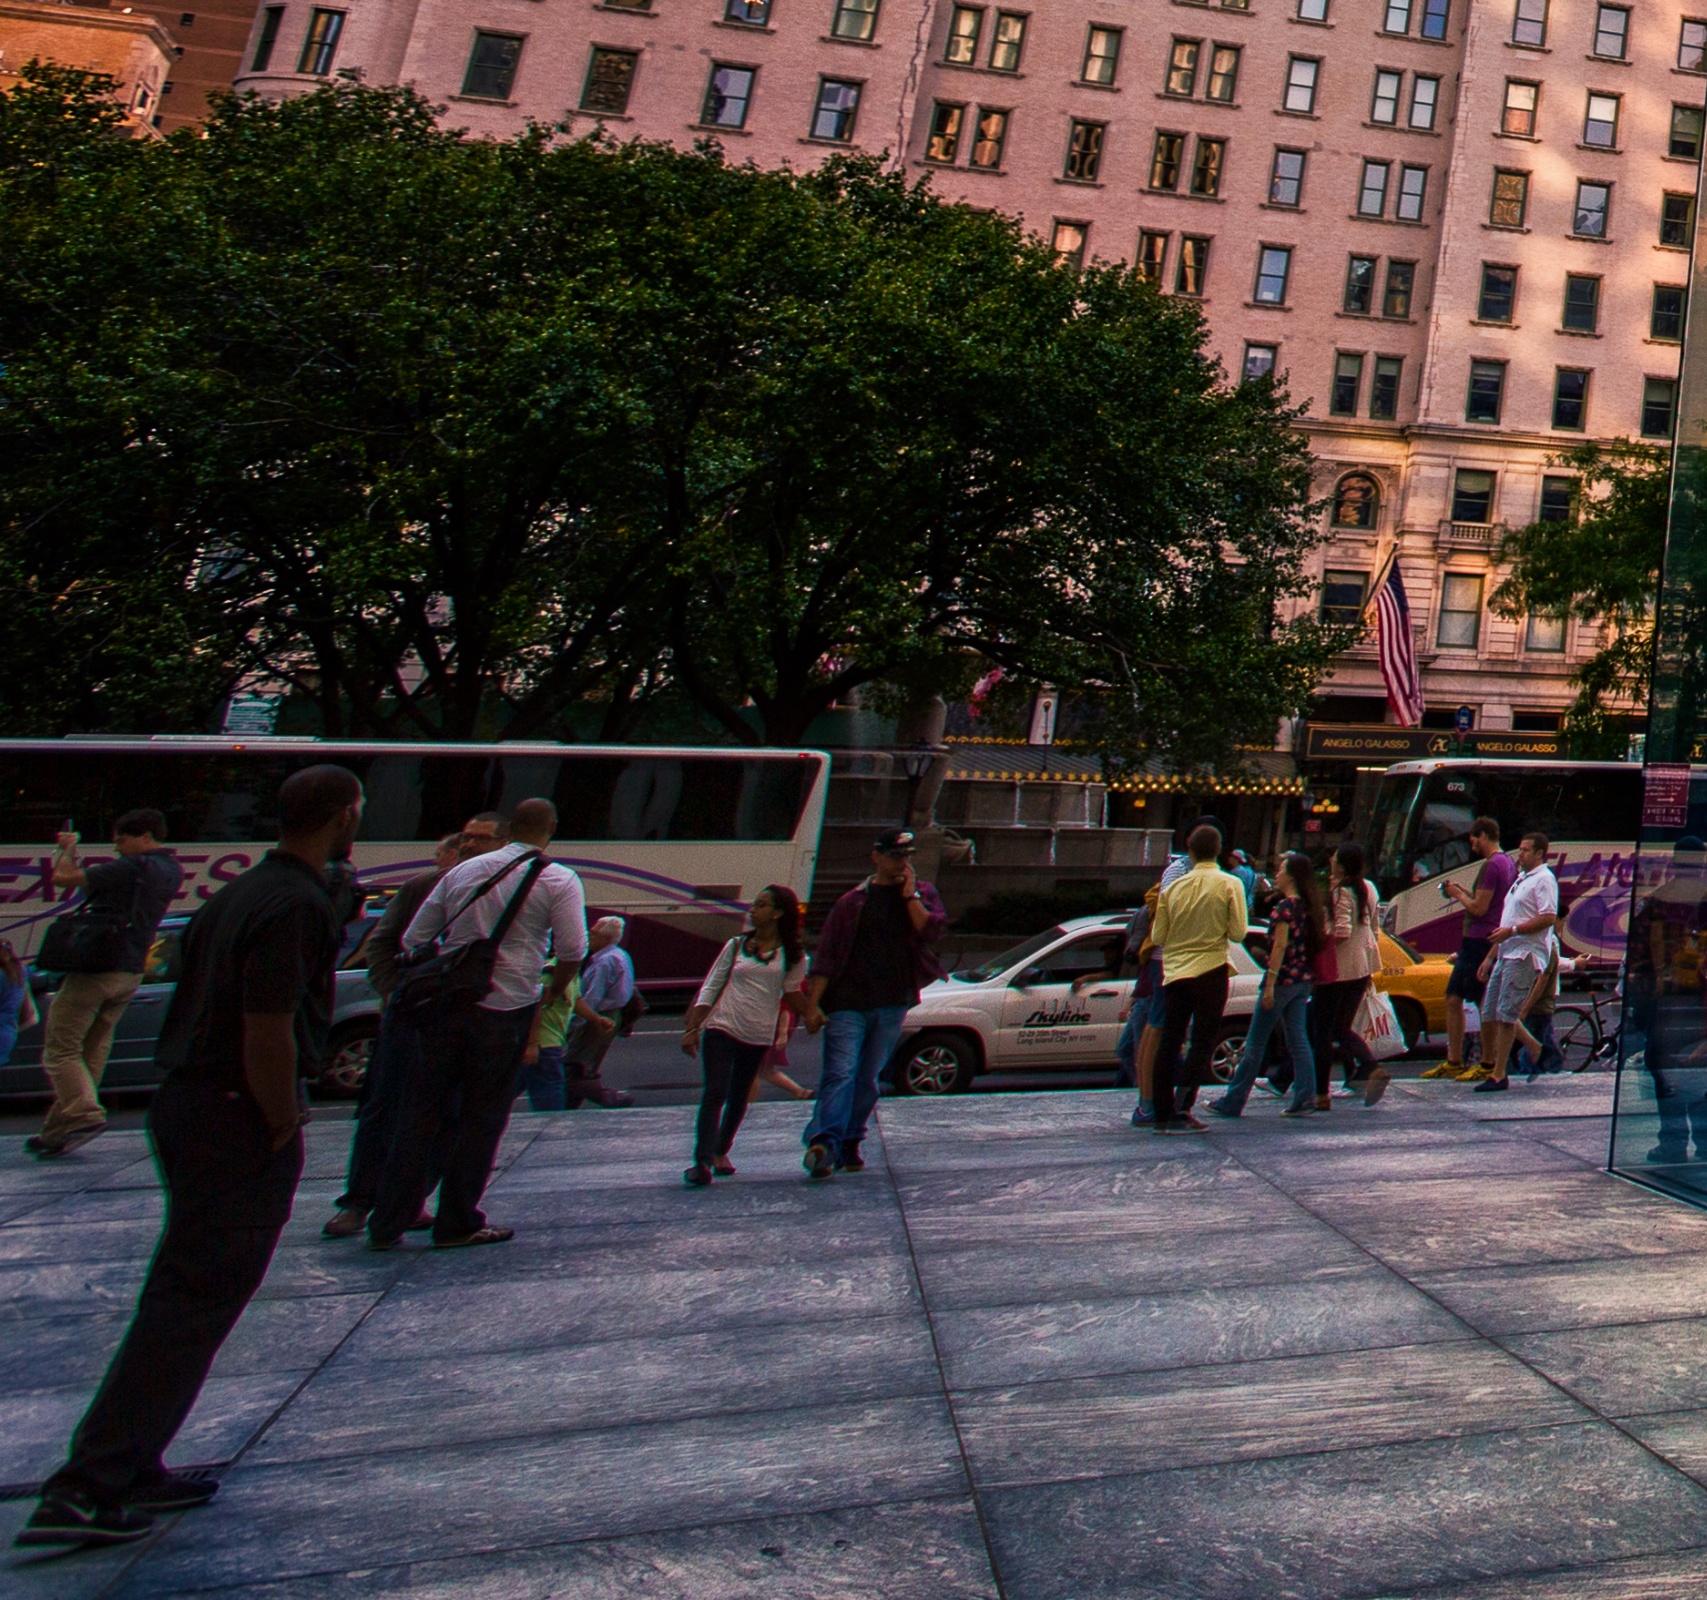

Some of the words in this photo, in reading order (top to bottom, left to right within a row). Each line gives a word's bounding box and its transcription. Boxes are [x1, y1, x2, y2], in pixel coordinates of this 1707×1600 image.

[1322, 738, 1363, 749] ANGELO
[1364, 738, 1410, 749] GALASSO
[1476, 742, 1512, 752] ANGELO
[1514, 743, 1557, 753] GALASSO
[1447, 782, 1465, 792] 673
[1023, 1010, 1092, 1028] Skyline
